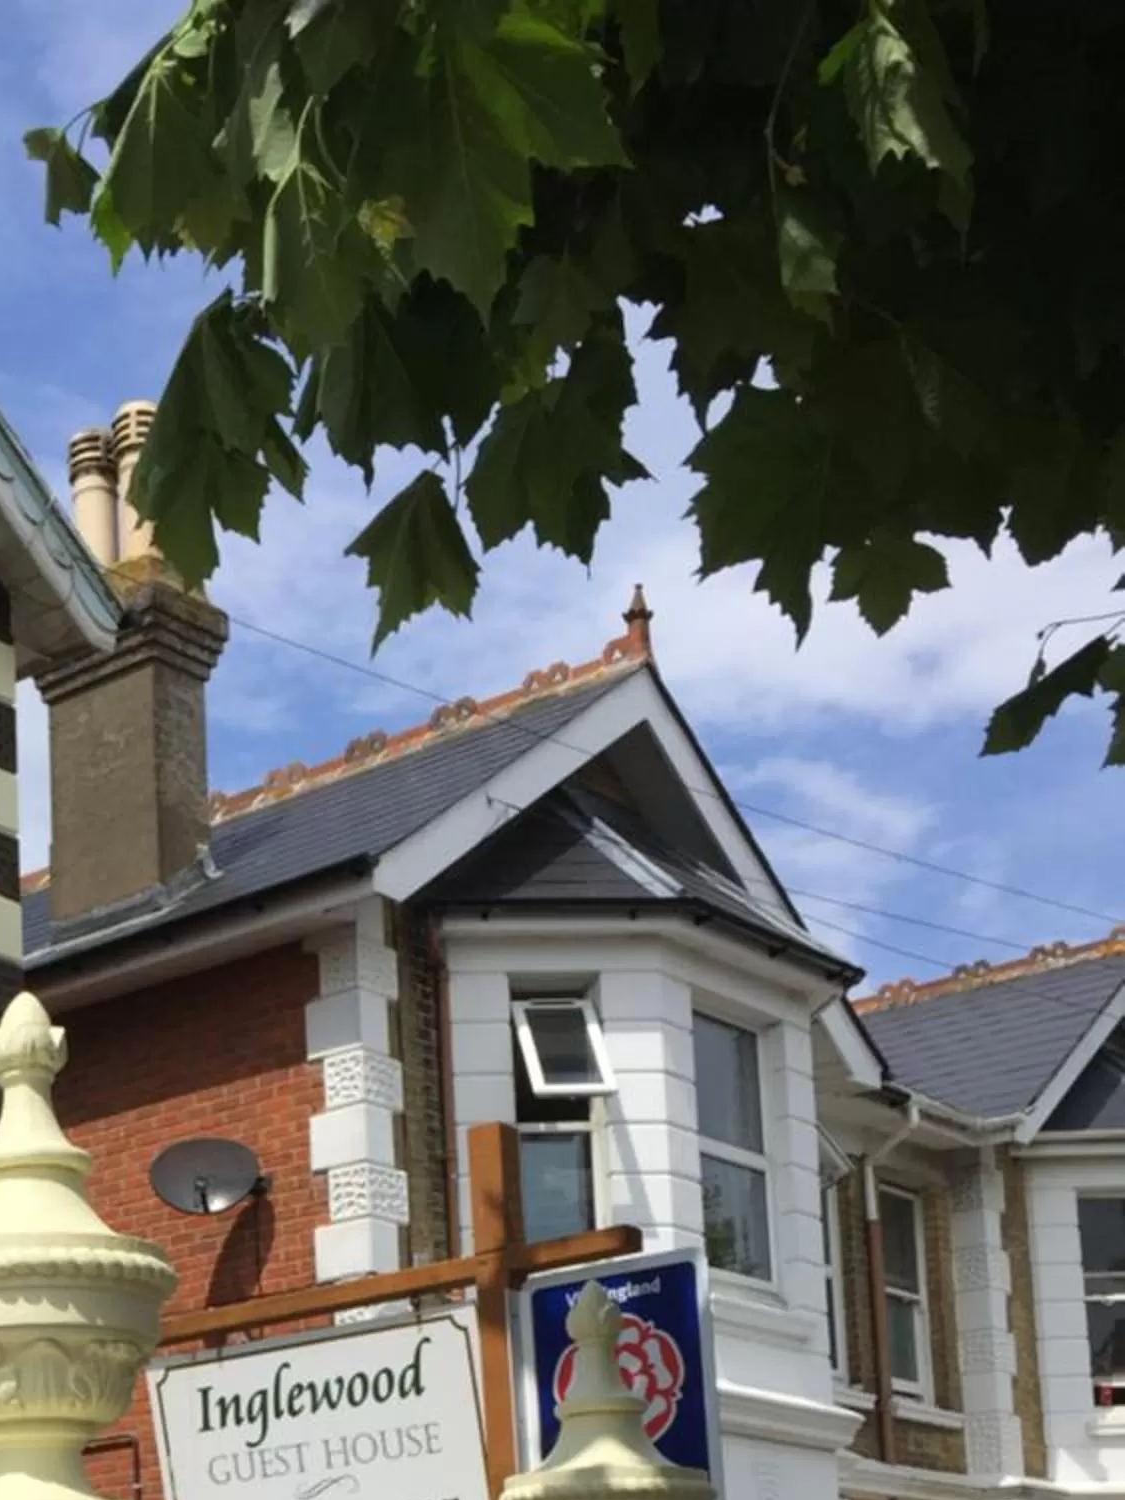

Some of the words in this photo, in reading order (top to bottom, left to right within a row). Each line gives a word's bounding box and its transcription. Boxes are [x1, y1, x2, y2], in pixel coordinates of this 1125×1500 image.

[197, 1337, 431, 1447] Inglewood
[207, 1443, 309, 1486] GUEST
[323, 1422, 443, 1471] HOUSE
